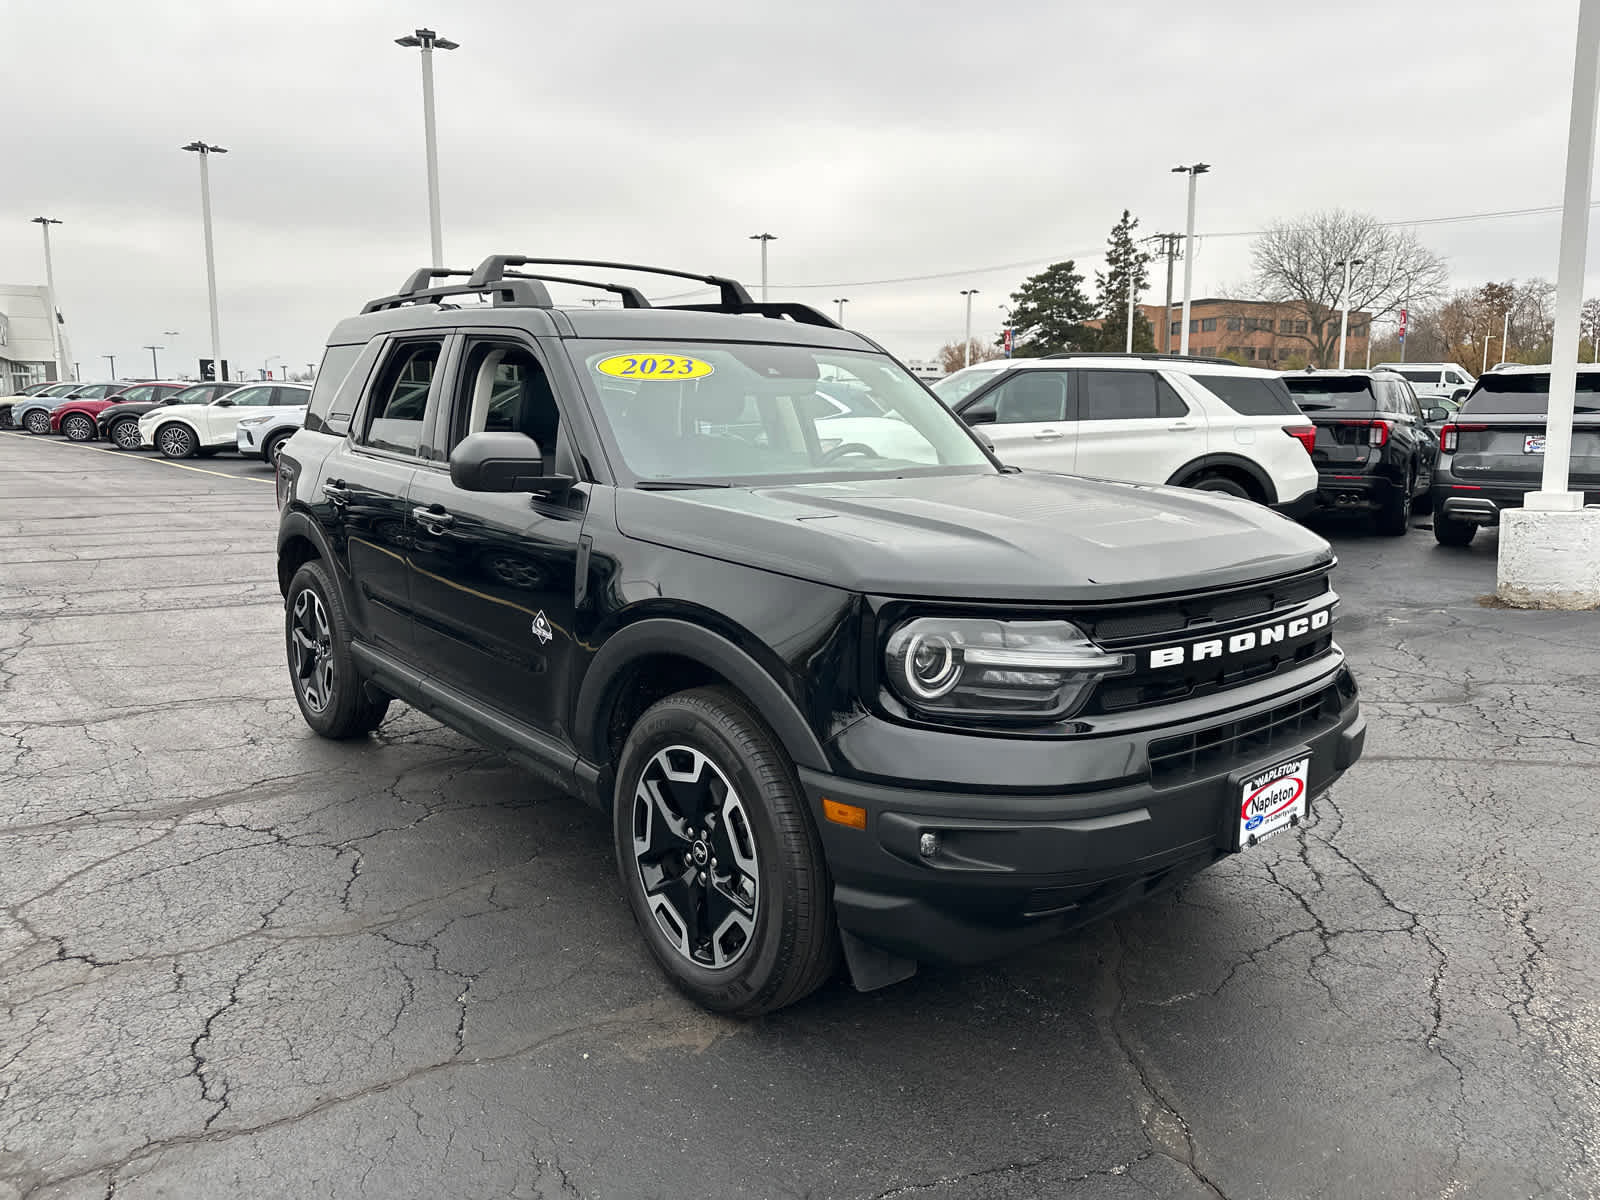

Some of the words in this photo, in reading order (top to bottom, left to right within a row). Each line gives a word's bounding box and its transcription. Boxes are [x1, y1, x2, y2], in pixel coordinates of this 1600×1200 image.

[621, 358, 693, 375] 2023
[1150, 610, 1329, 668] BRONCO
[1258, 763, 1297, 786] NAPLETON
[1251, 787, 1294, 814] Napleton
